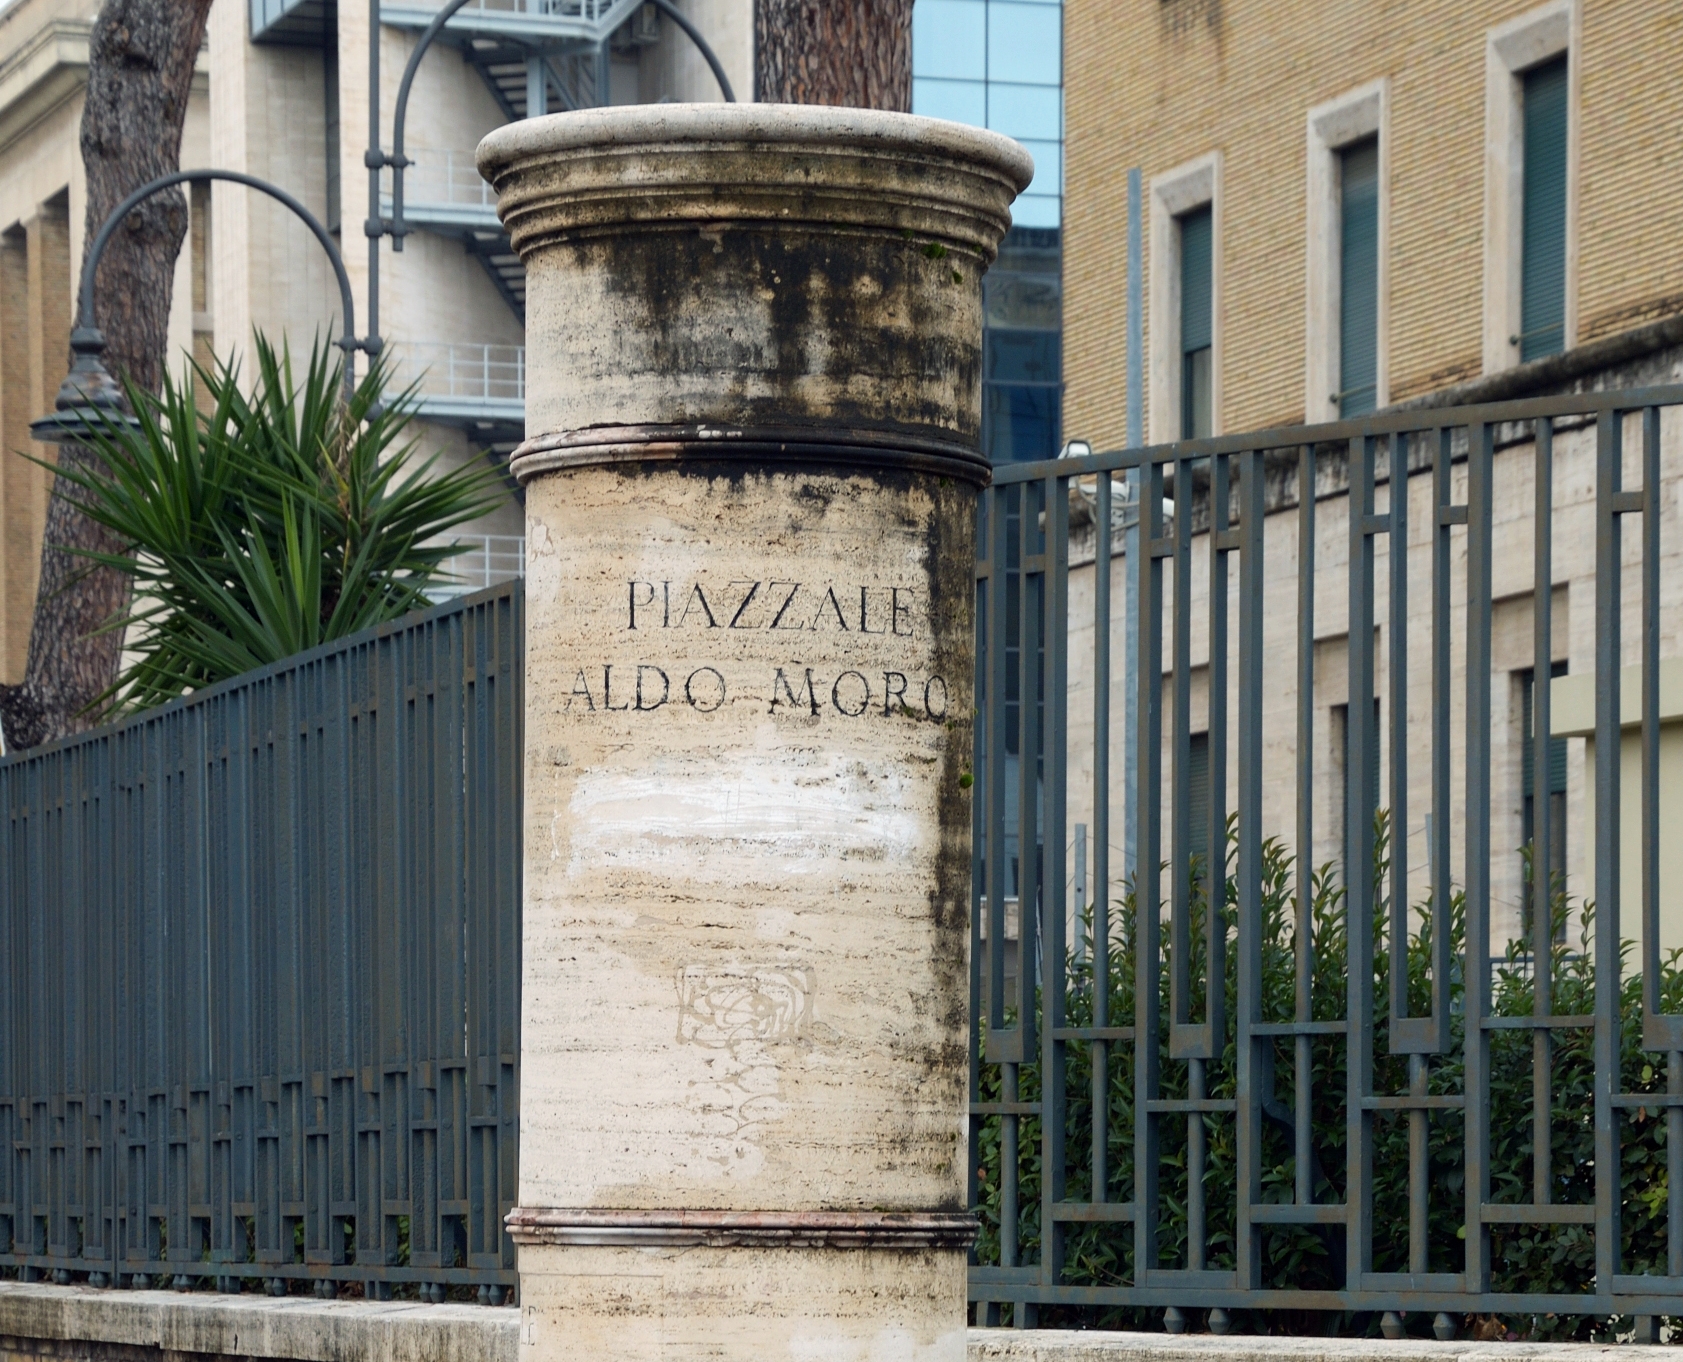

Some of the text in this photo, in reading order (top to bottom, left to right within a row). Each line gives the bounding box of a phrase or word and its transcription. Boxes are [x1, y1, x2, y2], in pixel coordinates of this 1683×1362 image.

[627, 580, 914, 637] PIAZZALE
[564, 664, 948, 723] ALDO MORO
